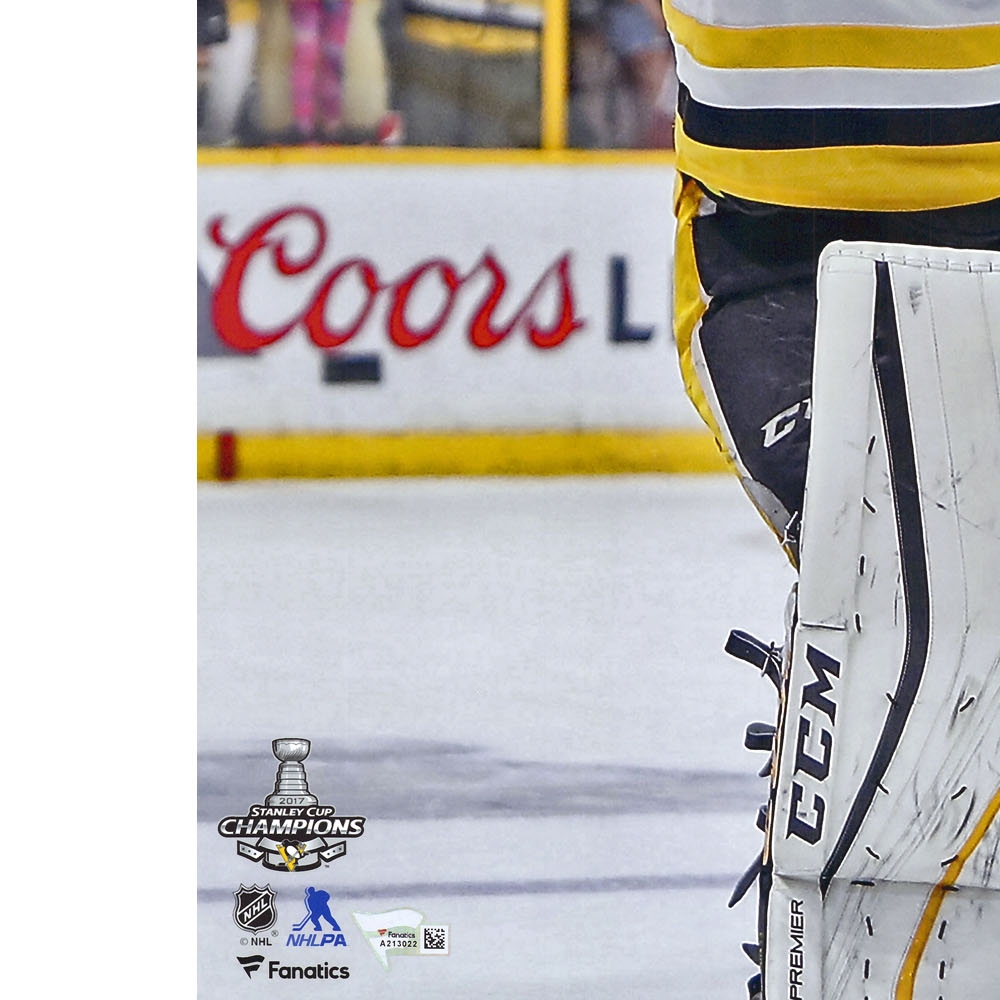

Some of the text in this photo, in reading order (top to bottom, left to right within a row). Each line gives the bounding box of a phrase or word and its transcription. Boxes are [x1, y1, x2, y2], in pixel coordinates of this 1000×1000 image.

[206, 203, 586, 350] Coors
[785, 641, 843, 846] CCM
[380, 939, 418, 948] A213022
[388, 931, 416, 939] Fanatics
[788, 899, 805, 1000] PREMIER
